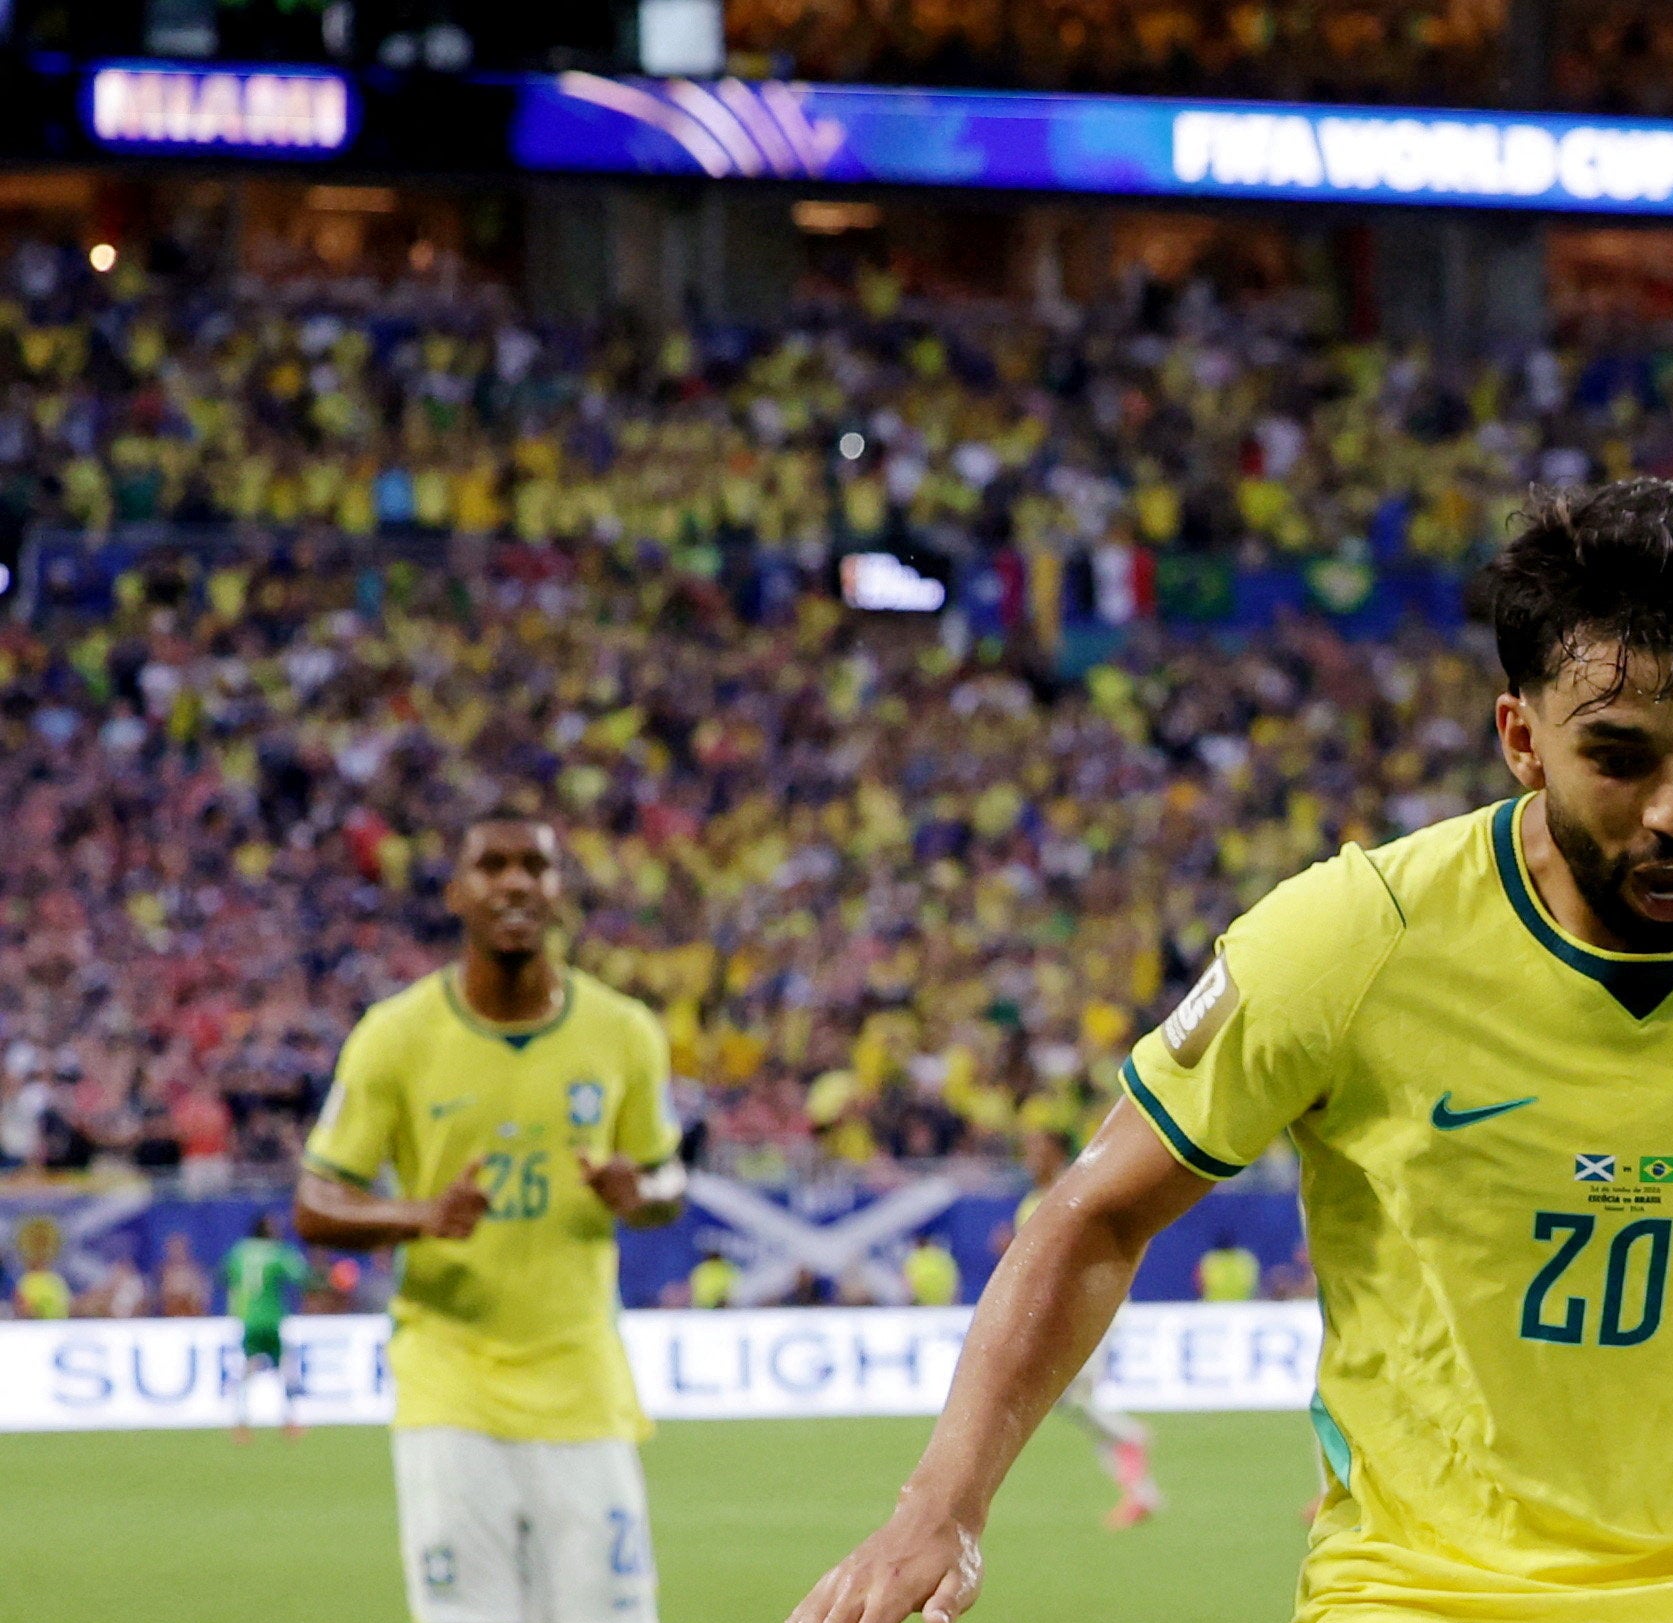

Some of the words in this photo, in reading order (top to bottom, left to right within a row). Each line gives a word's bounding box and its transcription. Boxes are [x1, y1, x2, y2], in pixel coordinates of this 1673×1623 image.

[1318, 117, 1558, 197] WORLD
[484, 1151, 550, 1221] 26
[1520, 1209, 1673, 1347] 20
